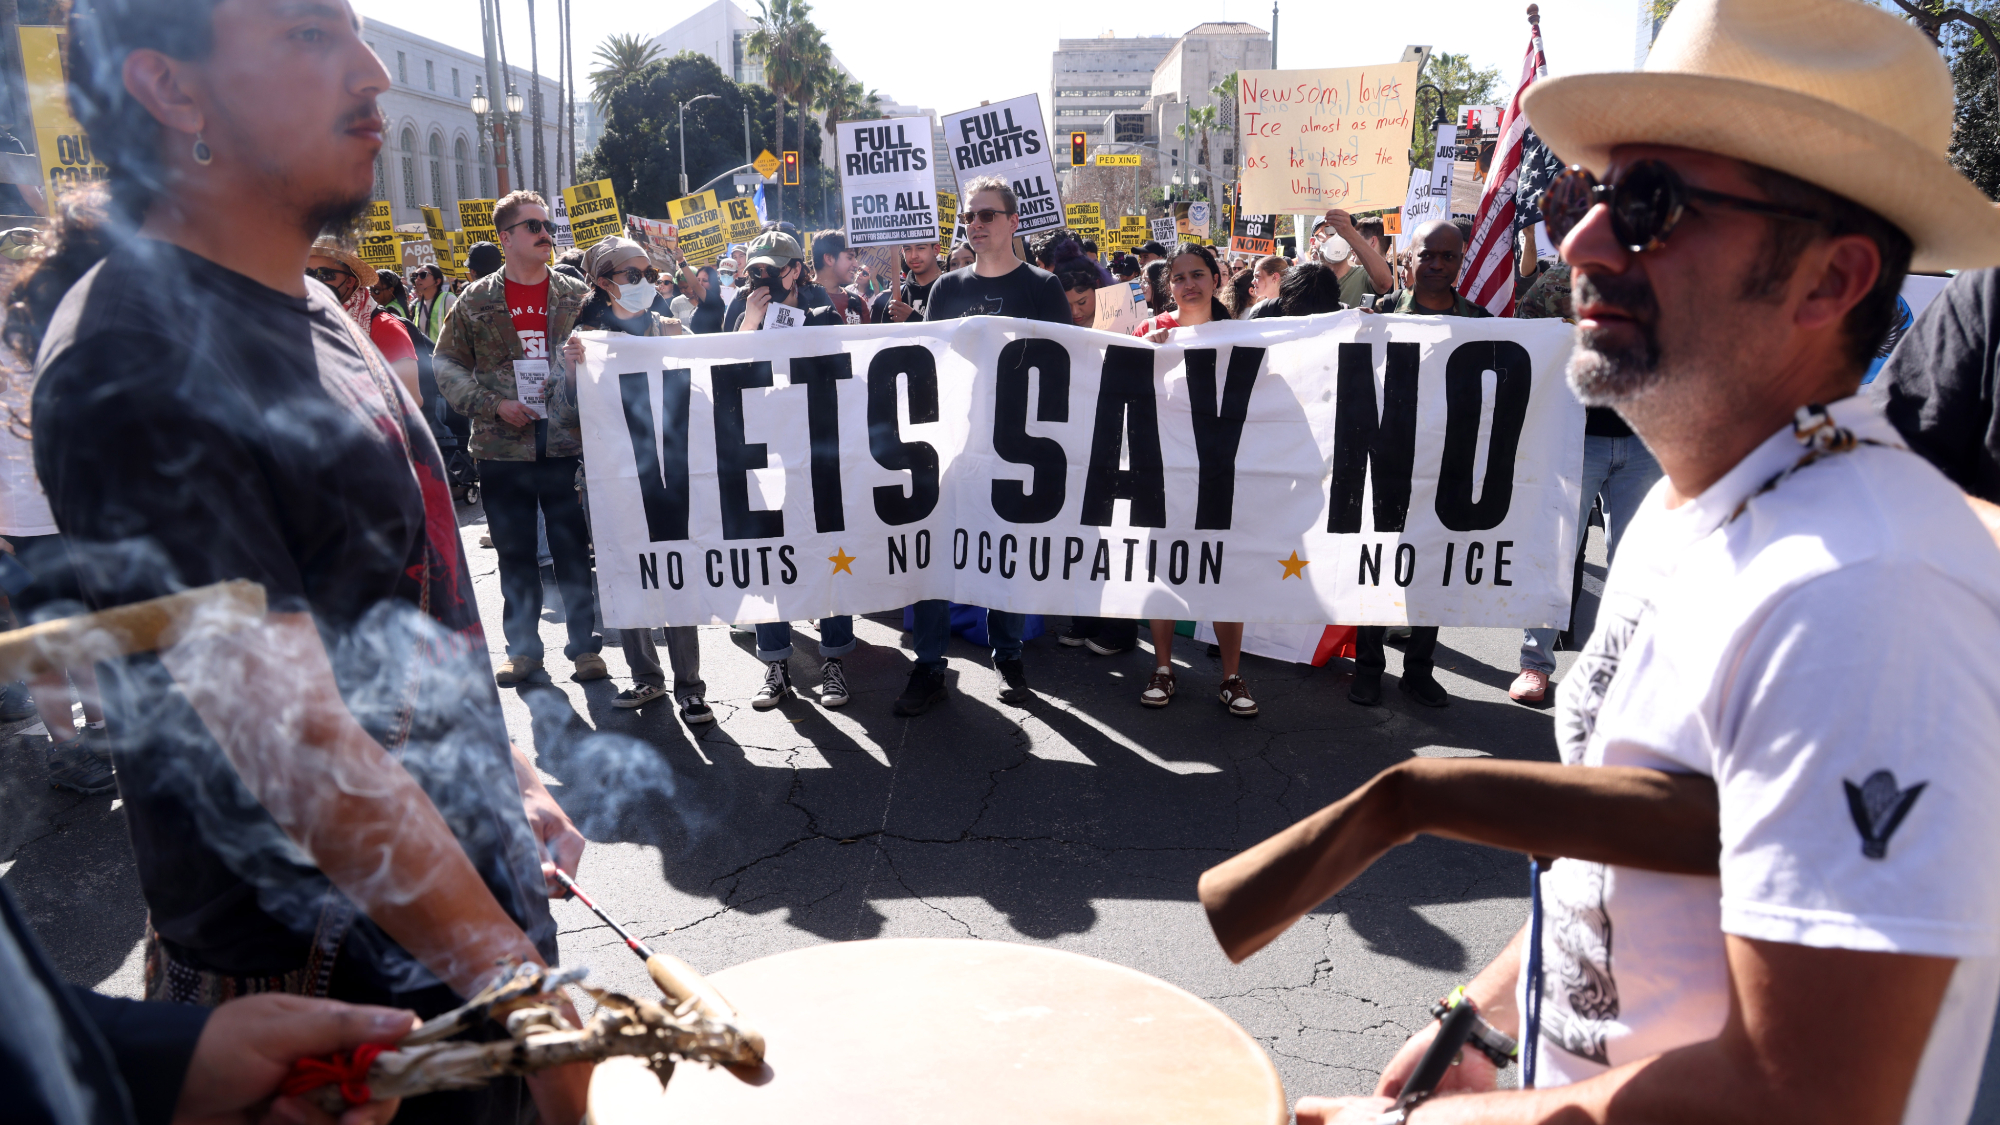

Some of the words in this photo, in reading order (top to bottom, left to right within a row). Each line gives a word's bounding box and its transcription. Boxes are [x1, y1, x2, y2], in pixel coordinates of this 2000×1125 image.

[1243, 78, 1338, 104] Newsom
[1359, 72, 1402, 103] loves
[959, 108, 1022, 144] FULL
[1244, 112, 1282, 137] Ice
[1301, 116, 1340, 133] almost
[1352, 121, 1367, 130] as
[1376, 109, 1409, 130] much
[854, 124, 912, 152] FULL
[57, 134, 91, 165] OU
[955, 129, 1041, 171] RIGHTS
[1099, 156, 1116, 164] PED
[1118, 156, 1137, 164] XING
[1247, 154, 1269, 169] as
[1290, 147, 1304, 168] he
[1320, 146, 1358, 168] hates
[1375, 147, 1393, 165] the
[846, 147, 927, 176] RIGHTS
[1013, 175, 1050, 199] ALL
[1291, 176, 1349, 198] Unhoused
[459, 202, 483, 213] EXPAND
[483, 201, 495, 212] THE
[569, 200, 600, 218] JUSTICE
[599, 197, 615, 210] FOR
[728, 199, 751, 220] ICE
[852, 193, 888, 215] FOR
[894, 191, 930, 212] ALL
[1067, 206, 1077, 215] LOS
[1077, 206, 1099, 214] ANGELES
[461, 212, 494, 227] GENERA
[572, 213, 618, 231] RENEE
[677, 213, 705, 230] JUSTICE
[704, 209, 719, 221] FOR
[730, 223, 740, 231] OUT
[746, 220, 756, 228] OUR
[851, 212, 933, 230] IMMIGRANTS
[1246, 223, 1262, 236] GO
[362, 234, 393, 245] TOP
[574, 226, 599, 242] NICOLE
[599, 222, 621, 236] GOOD
[678, 224, 721, 243] RENEE
[852, 233, 867, 242] PARTY
[867, 232, 877, 241] FOR
[876, 230, 900, 240] SOCIALISM
[906, 228, 934, 238] LIBERATION
[362, 244, 395, 258] TERROR
[404, 244, 435, 257] ABOL
[680, 239, 705, 254] NICOLE
[704, 233, 723, 248] GOOD
[1236, 238, 1269, 252] NOW!
[526, 305, 535, 314] &
[619, 344, 939, 542] VETS
[991, 338, 1266, 531] SAY
[1327, 340, 1532, 534] NO
[888, 529, 931, 575] NO
[953, 528, 1224, 585] OCCUPATION
[1358, 542, 1416, 587] NO
[1442, 540, 1514, 587] ICE
[639, 551, 684, 590] NO
[705, 545, 798, 589] CUTS
